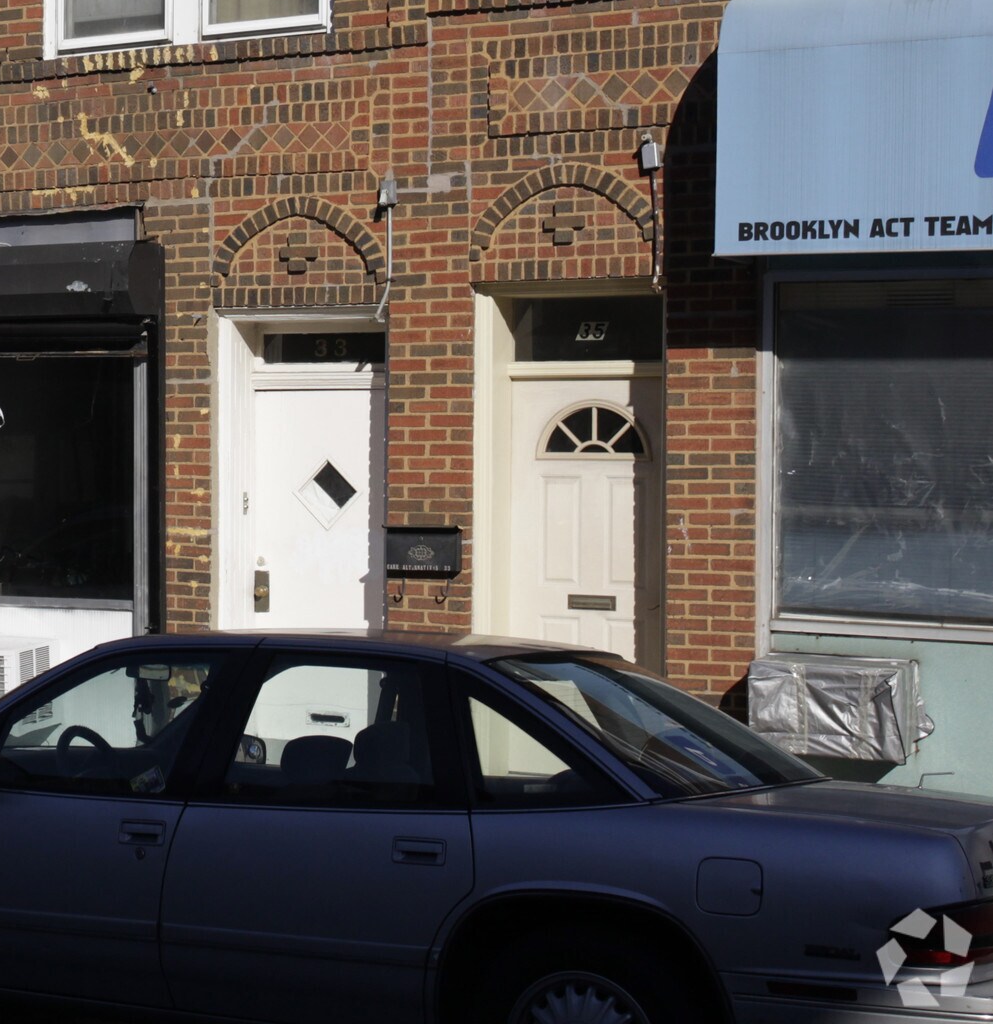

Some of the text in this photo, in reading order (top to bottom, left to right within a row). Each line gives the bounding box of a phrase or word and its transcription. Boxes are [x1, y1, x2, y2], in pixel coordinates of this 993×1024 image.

[738, 219, 860, 242] BROOKLYN
[869, 217, 915, 238] ACT
[579, 322, 606, 340] 35
[314, 338, 348, 357] 33
